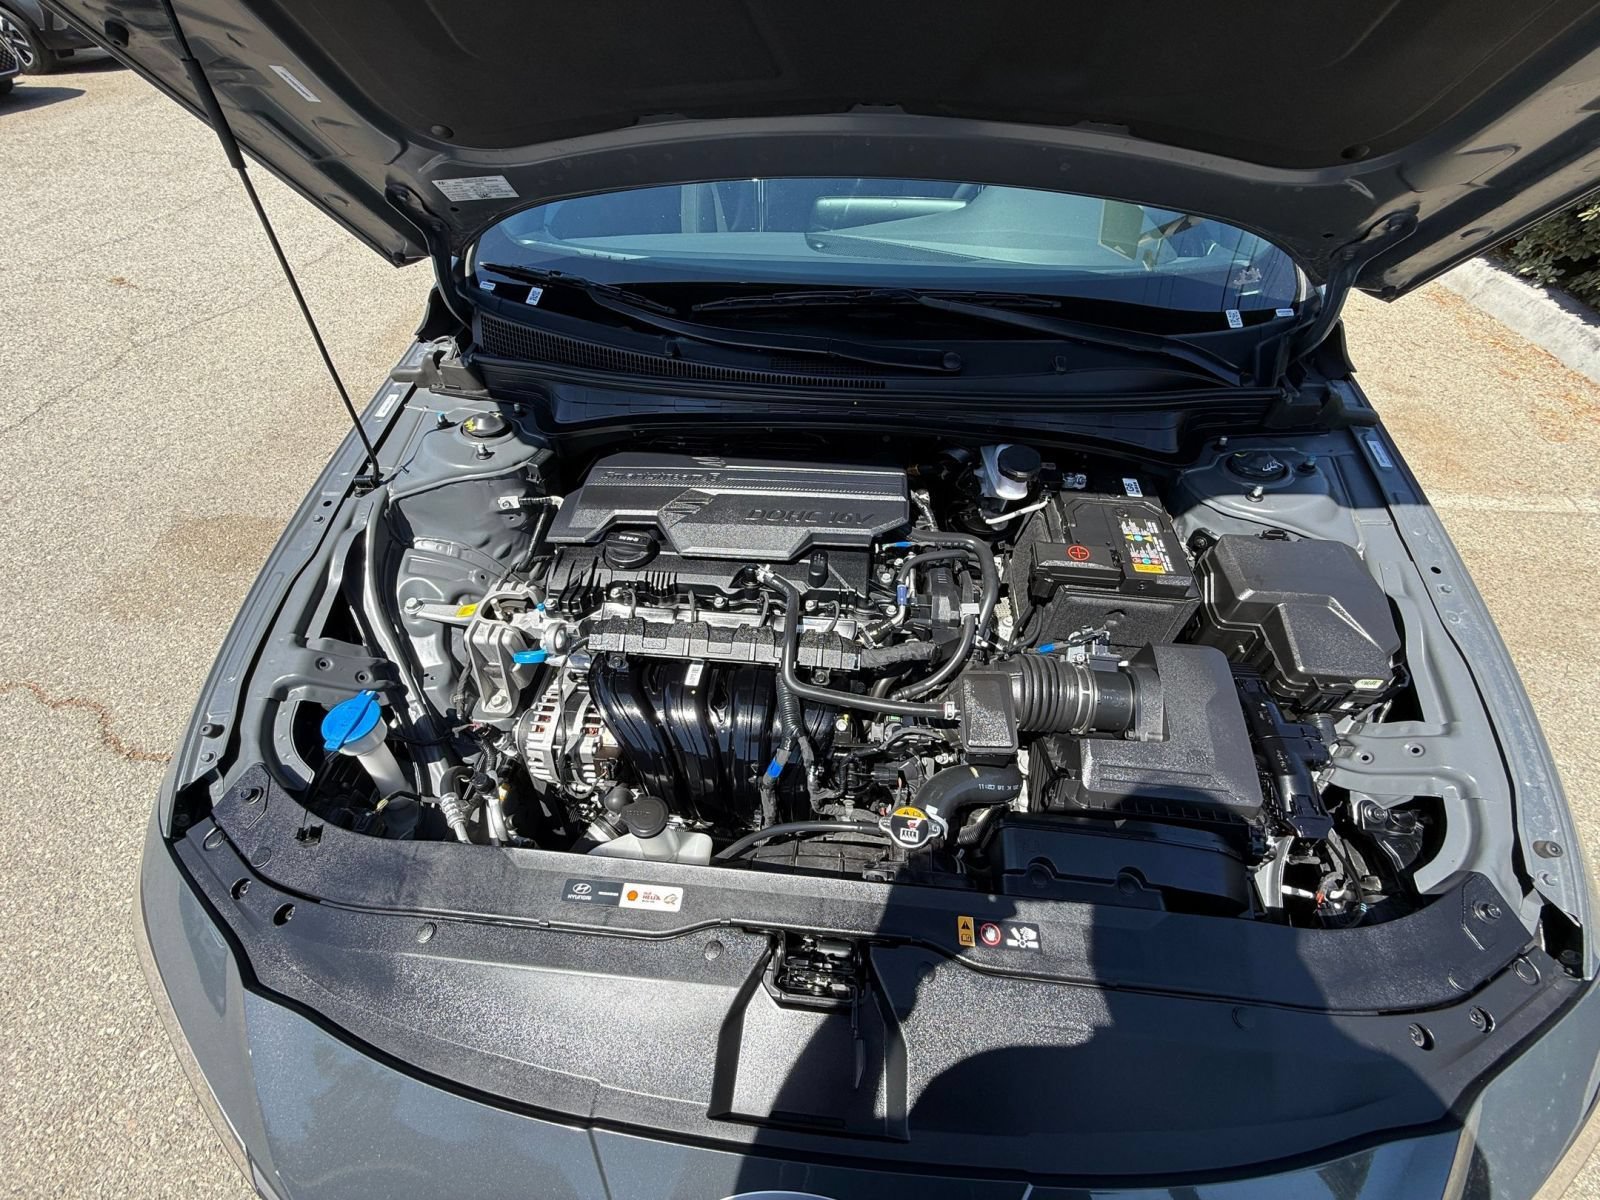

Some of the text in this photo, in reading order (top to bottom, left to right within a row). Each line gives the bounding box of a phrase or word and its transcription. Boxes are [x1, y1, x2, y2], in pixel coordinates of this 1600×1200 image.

[744, 509, 875, 525] DOHC 16V
[567, 893, 592, 901] HYUNDAI
